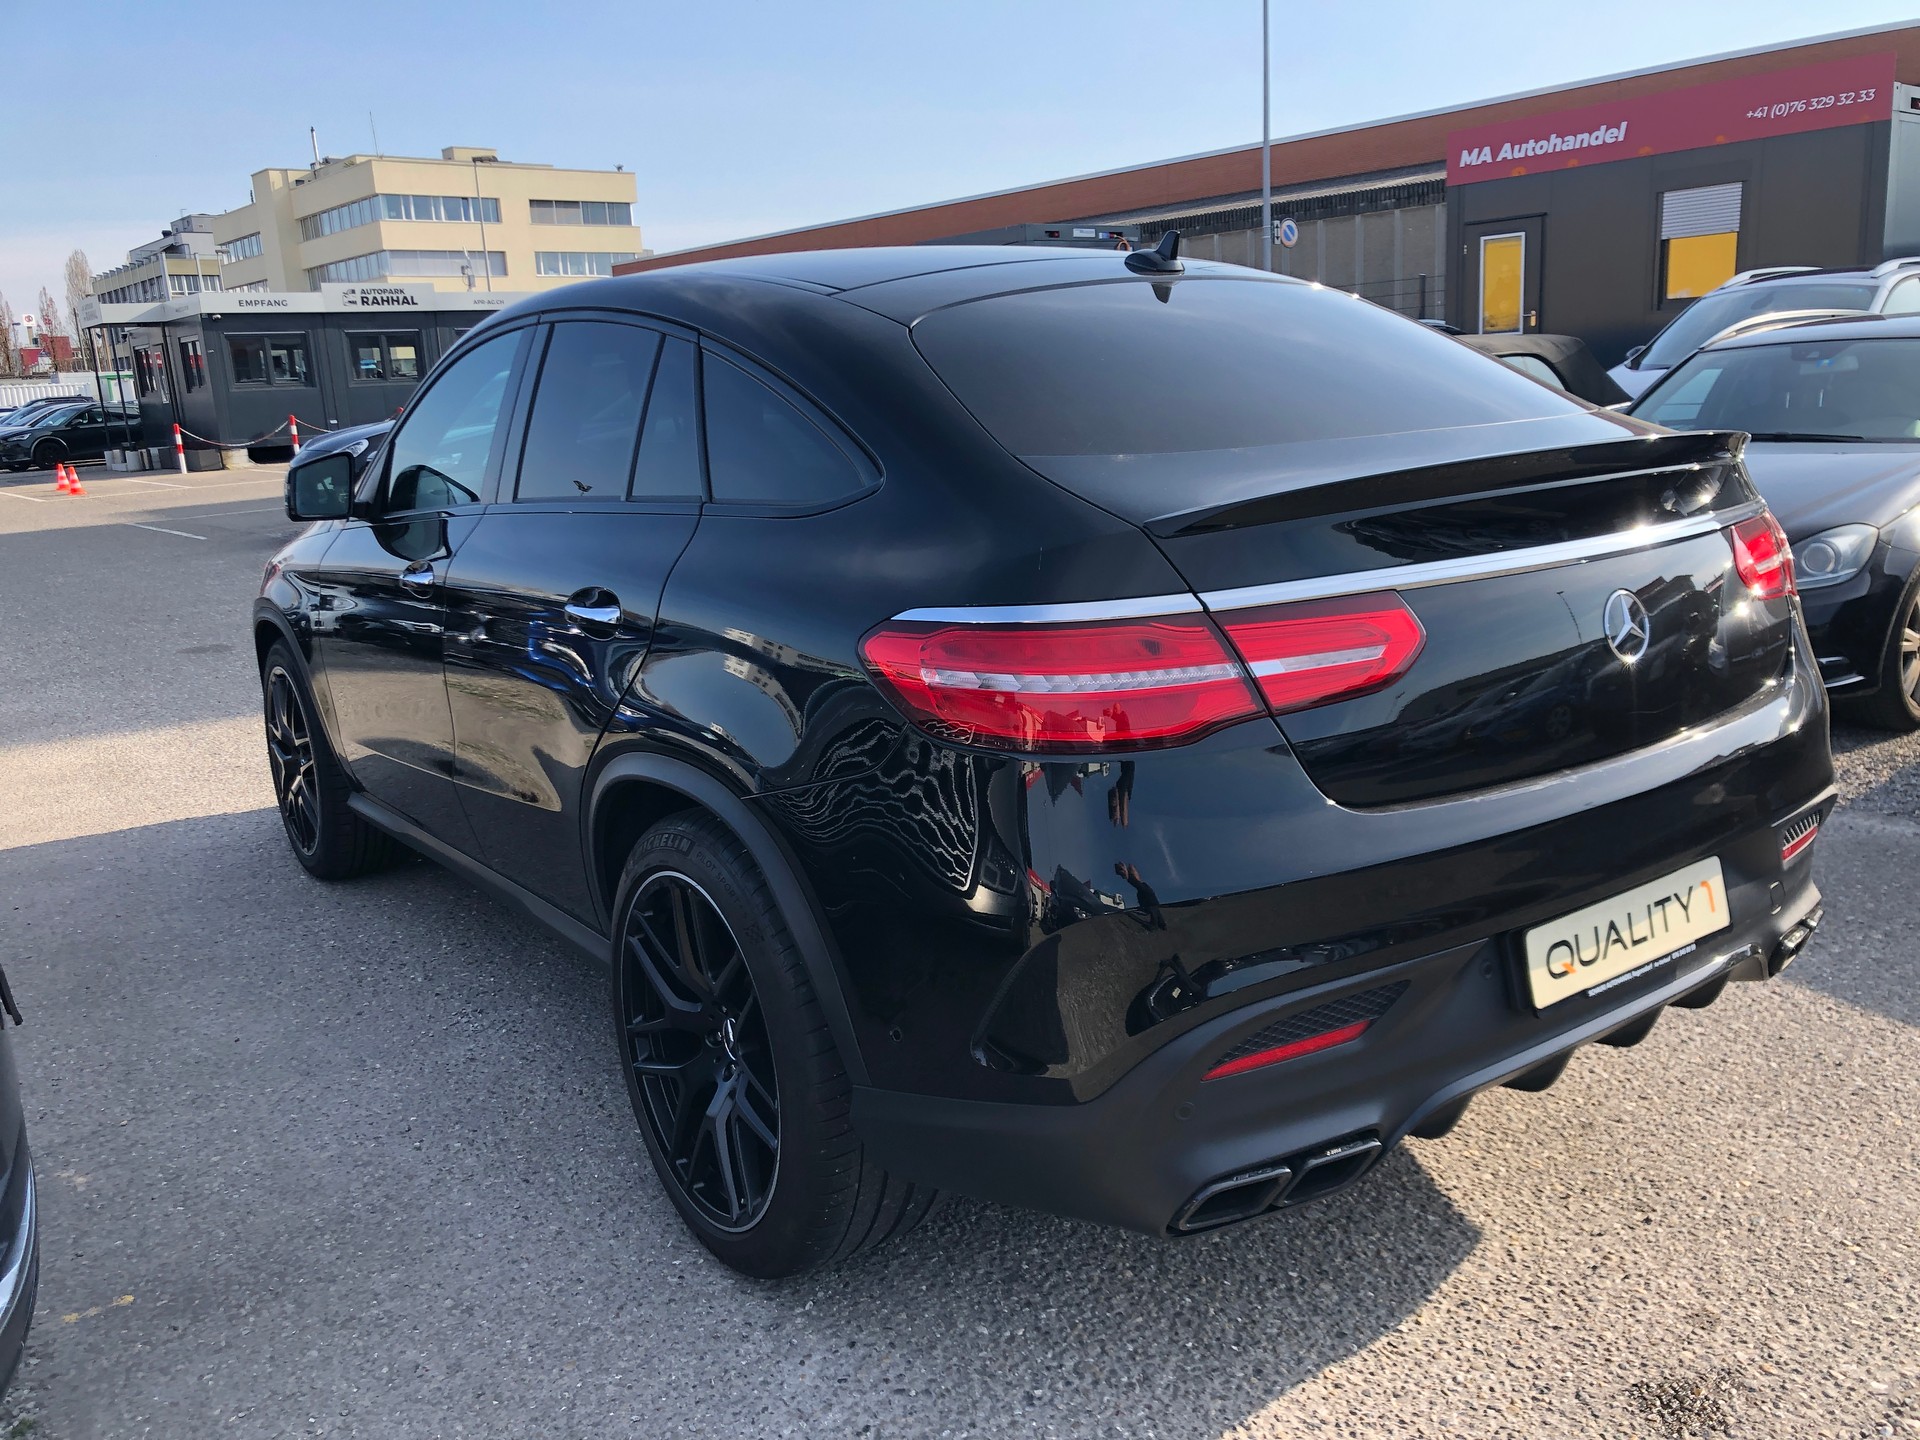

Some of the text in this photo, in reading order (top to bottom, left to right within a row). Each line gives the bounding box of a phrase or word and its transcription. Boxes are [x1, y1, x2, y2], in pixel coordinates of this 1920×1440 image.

[1746, 88, 1876, 118] +41 (0)76 329 32 33
[1459, 121, 1628, 167] MA Autohandel
[238, 299, 288, 307] EMPFANG
[360, 296, 419, 306] RAHHAL
[1545, 885, 1694, 979] QUALITY
[1699, 880, 1716, 913] 1
